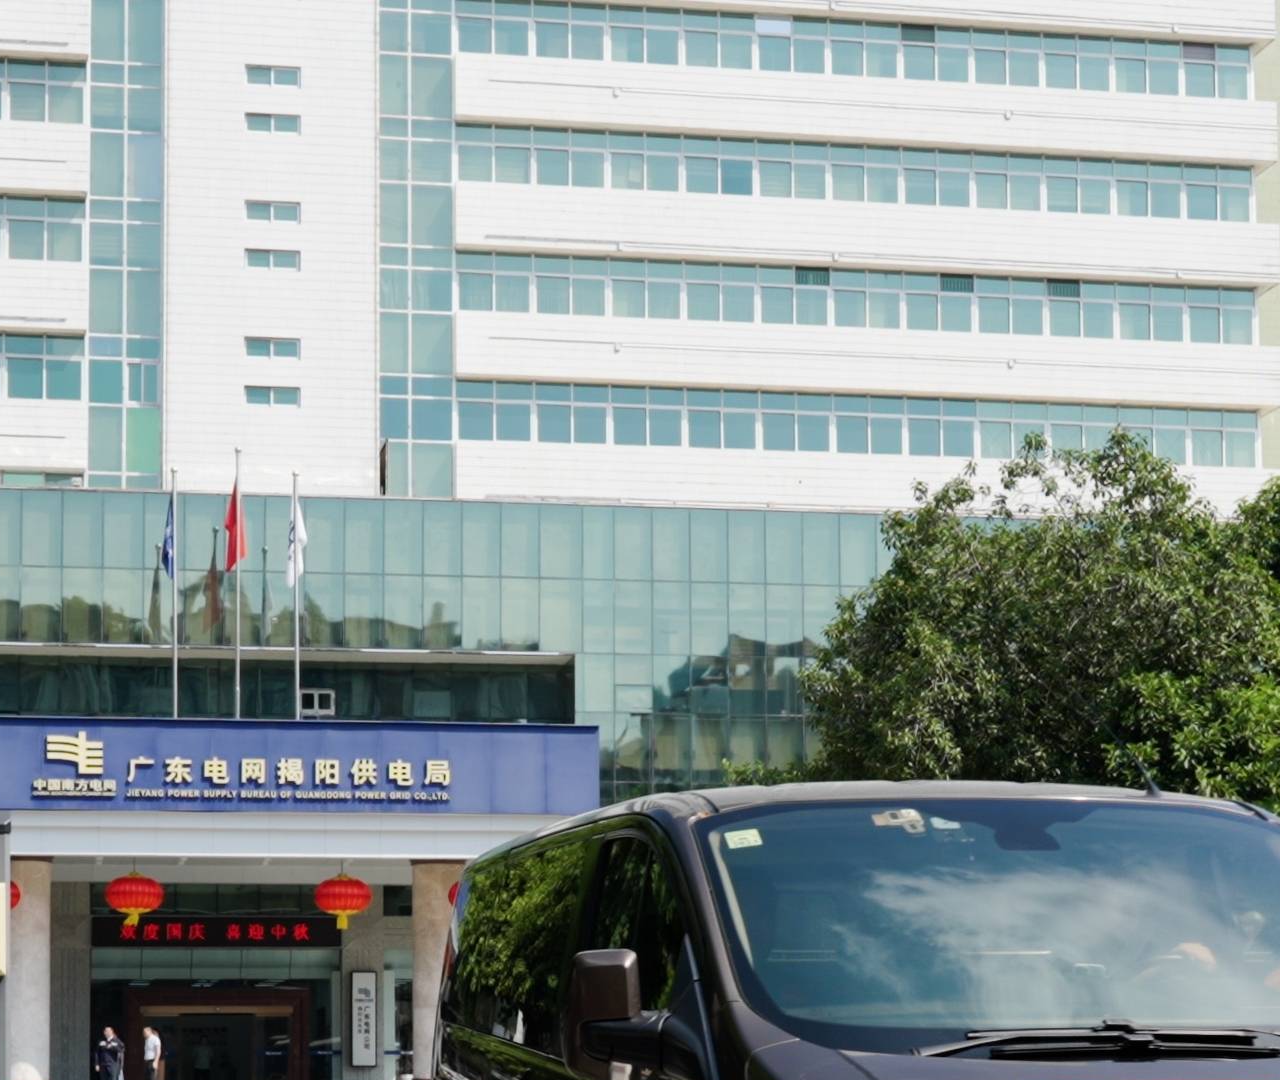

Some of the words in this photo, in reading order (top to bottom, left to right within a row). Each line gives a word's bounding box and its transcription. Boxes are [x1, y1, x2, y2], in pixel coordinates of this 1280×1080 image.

[127, 755, 450, 786] 广东电网揭阳供电局
[33, 778, 116, 792] 中国南方电网
[126, 788, 164, 798] JIEYANG
[167, 788, 200, 798] POWER
[203, 788, 237, 799] SUPPLY
[240, 789, 277, 799] BUREAU
[280, 790, 292, 799] OF
[295, 790, 352, 799] GUANGDONG
[355, 790, 386, 800] POWER
[389, 791, 411, 800] GRID
[226, 923, 309, 941] 喜迎中秋
